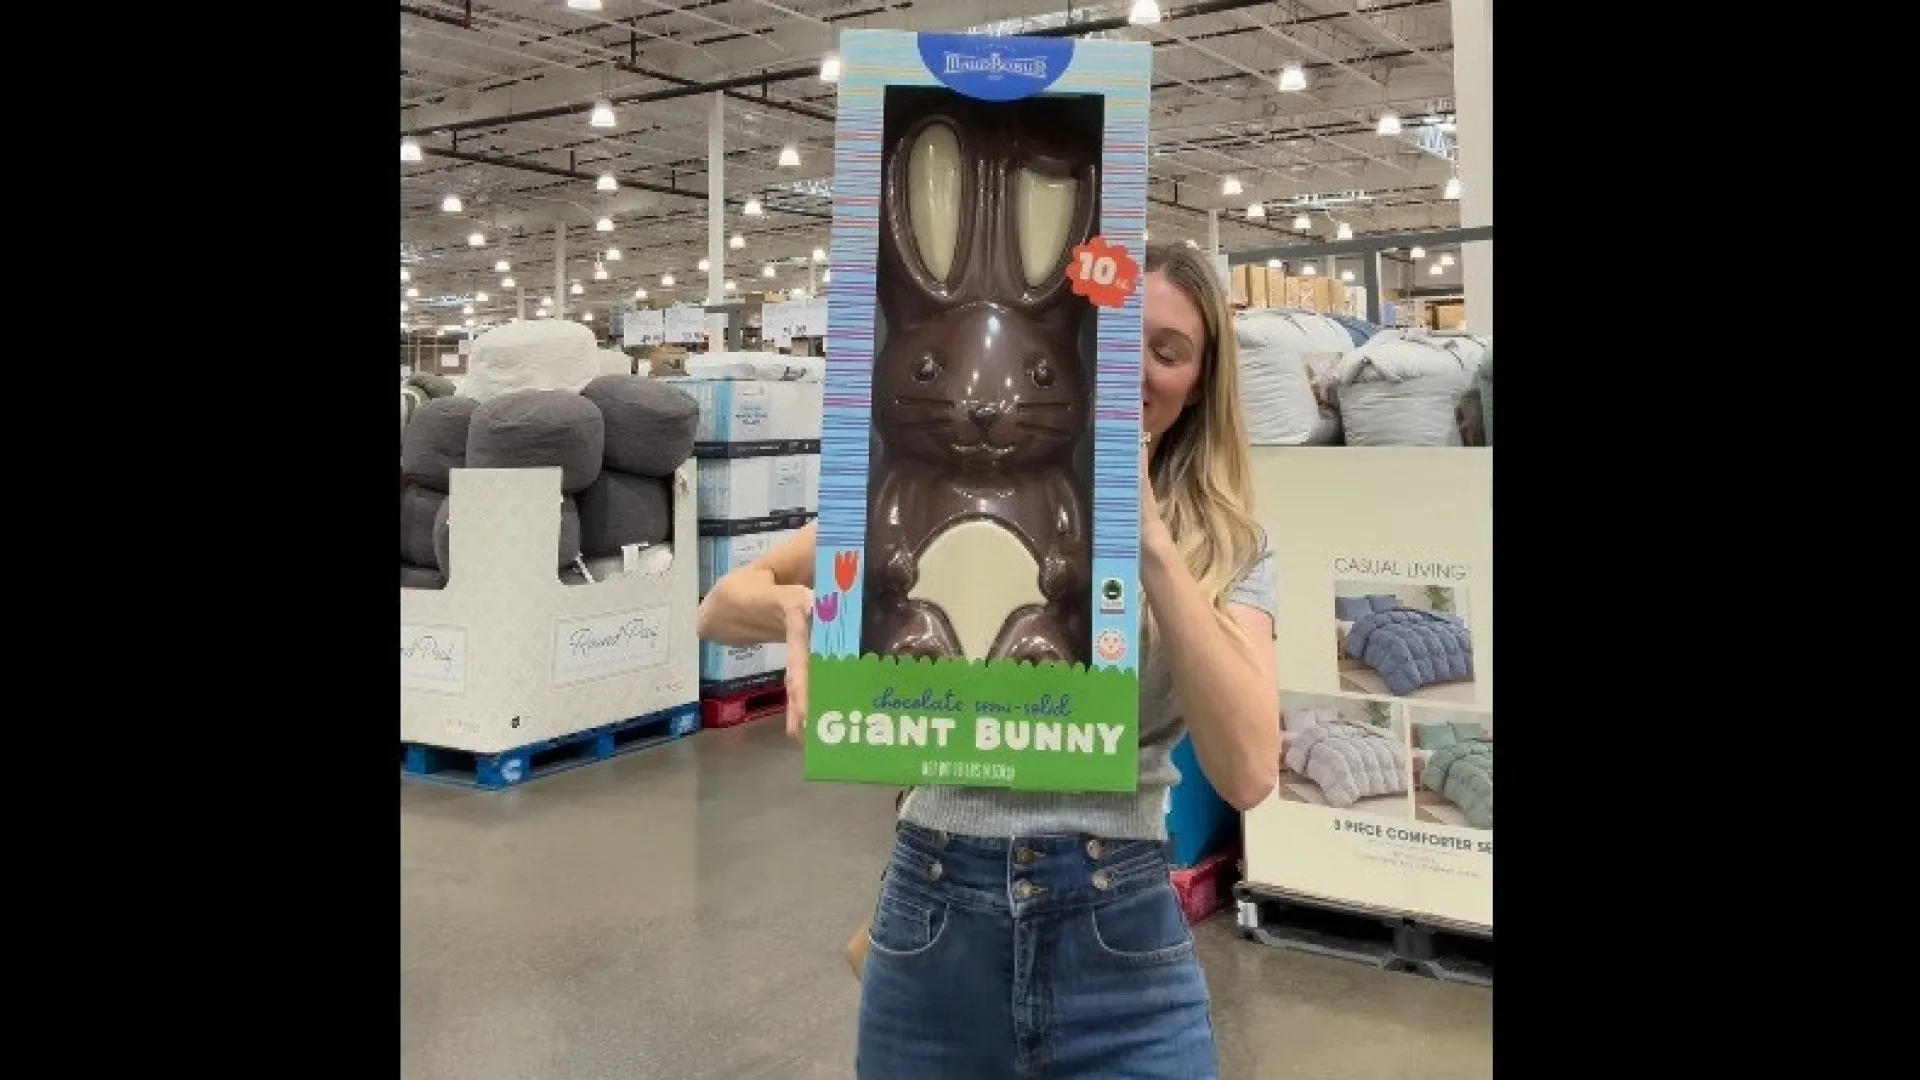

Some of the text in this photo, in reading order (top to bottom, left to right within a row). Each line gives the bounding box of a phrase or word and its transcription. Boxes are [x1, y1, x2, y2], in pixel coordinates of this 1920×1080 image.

[1079, 252, 1118, 285] 10
[1334, 557, 1402, 576] CASUAL
[872, 686, 1072, 717] chocolate semi-solid
[975, 716, 1126, 756] BUNNY
[1344, 819, 1382, 838] PIECE
[1386, 827, 1472, 851] COMFORTER
